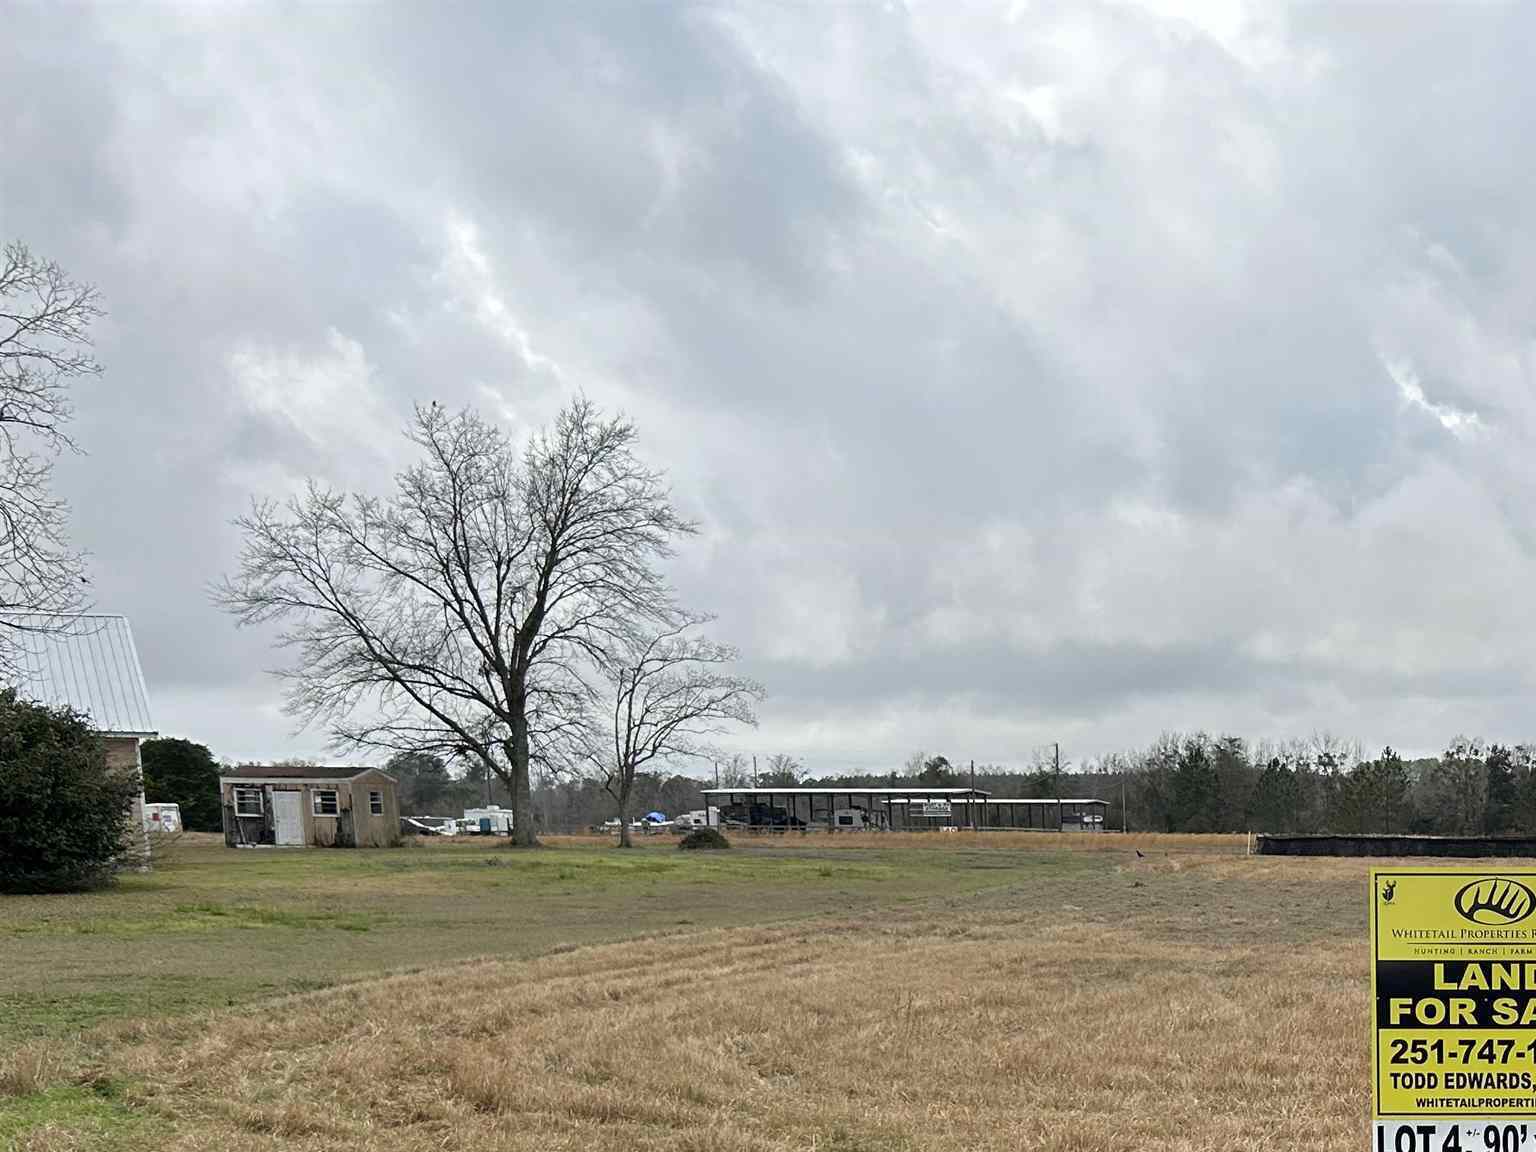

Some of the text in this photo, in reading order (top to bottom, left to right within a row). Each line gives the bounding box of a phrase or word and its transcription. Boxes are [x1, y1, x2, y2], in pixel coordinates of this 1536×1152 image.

[1392, 929, 1457, 938] WHITETAIL
[1461, 929, 1527, 938] PROPERTIES
[1390, 998, 1478, 1025] FOR
[1390, 1073, 1438, 1089] TODD
[1444, 1073, 1536, 1092] EDWARDS,
